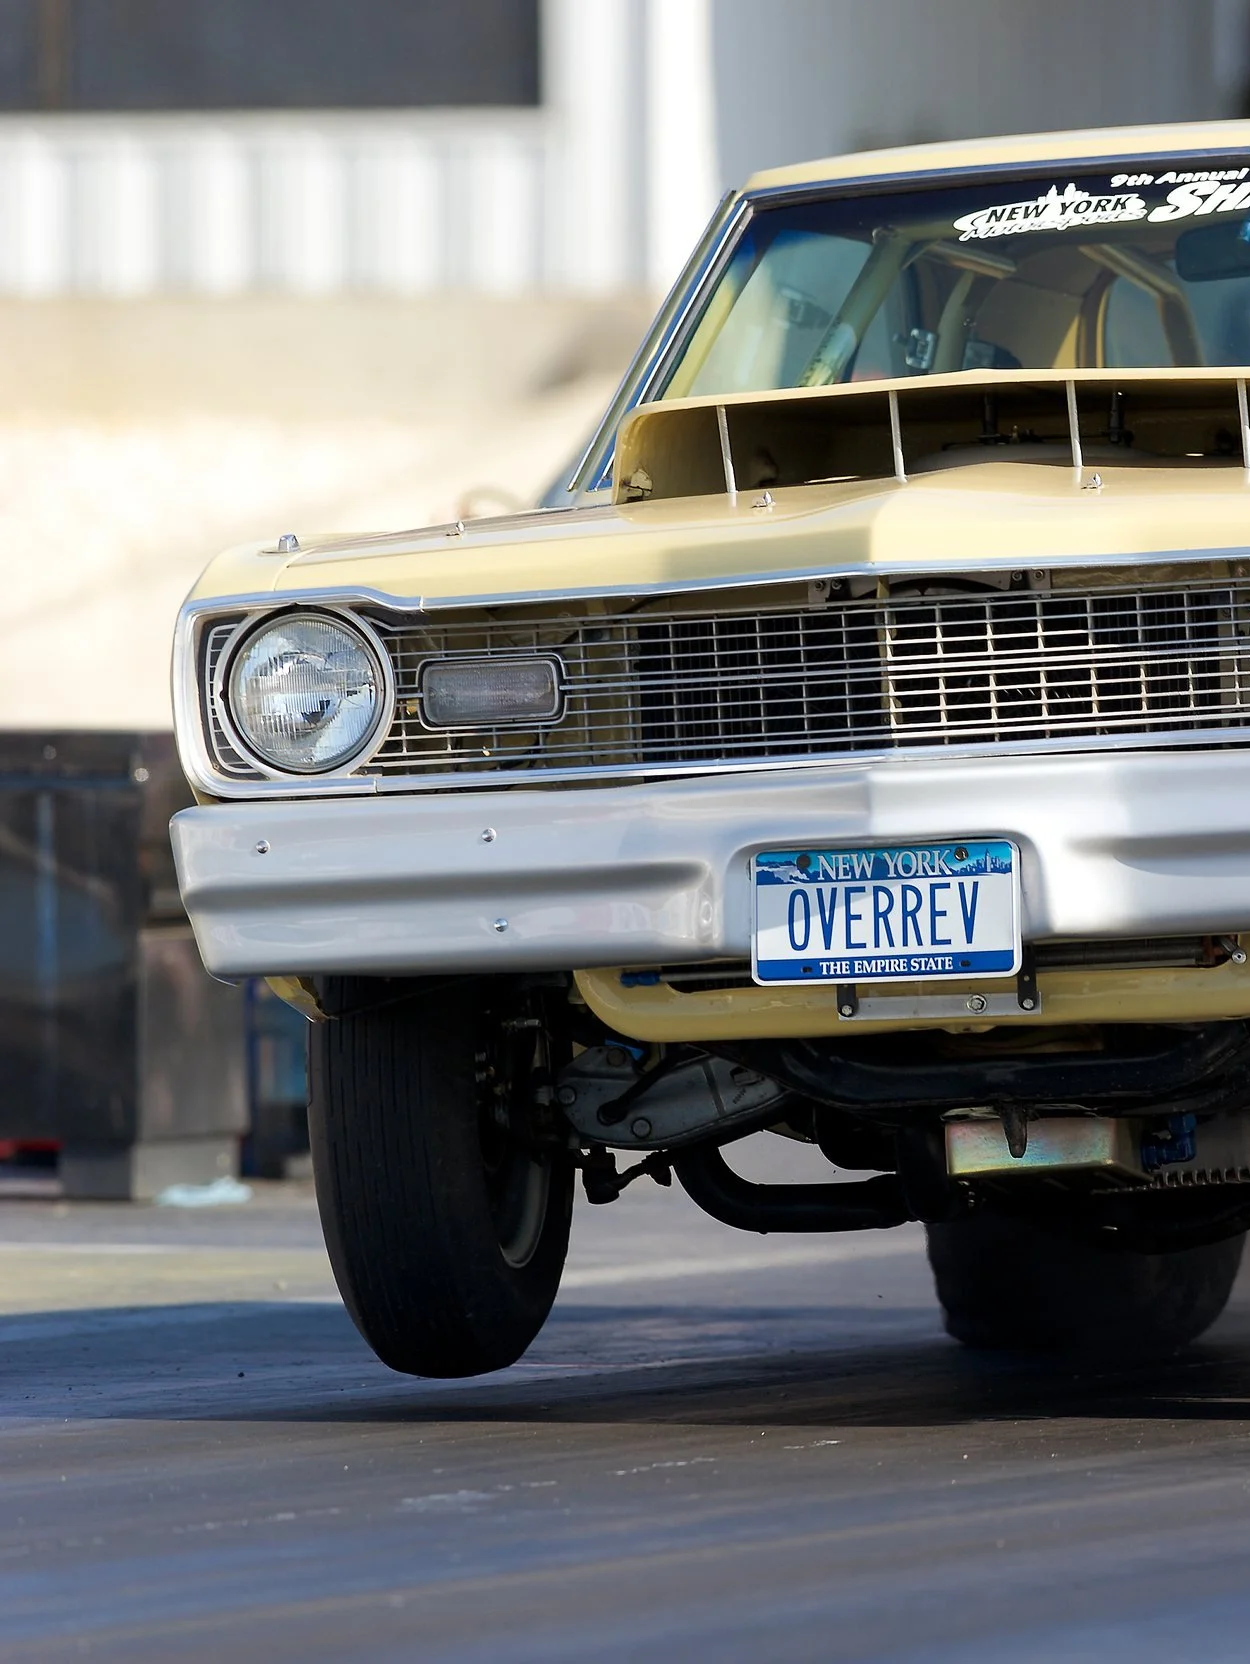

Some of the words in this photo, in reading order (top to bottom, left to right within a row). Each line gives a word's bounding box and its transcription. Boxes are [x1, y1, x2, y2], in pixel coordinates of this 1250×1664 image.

[1110, 172, 1154, 187] 9th
[1155, 168, 1250, 184] Annual
[985, 203, 1050, 224] NEW
[1060, 196, 1131, 216] YORK
[817, 852, 875, 880] NEW
[881, 849, 952, 878] YORK
[788, 881, 979, 951] OVERREV
[819, 961, 850, 975] THE
[854, 959, 908, 974] EMPIRE
[910, 957, 953, 971] STATE
